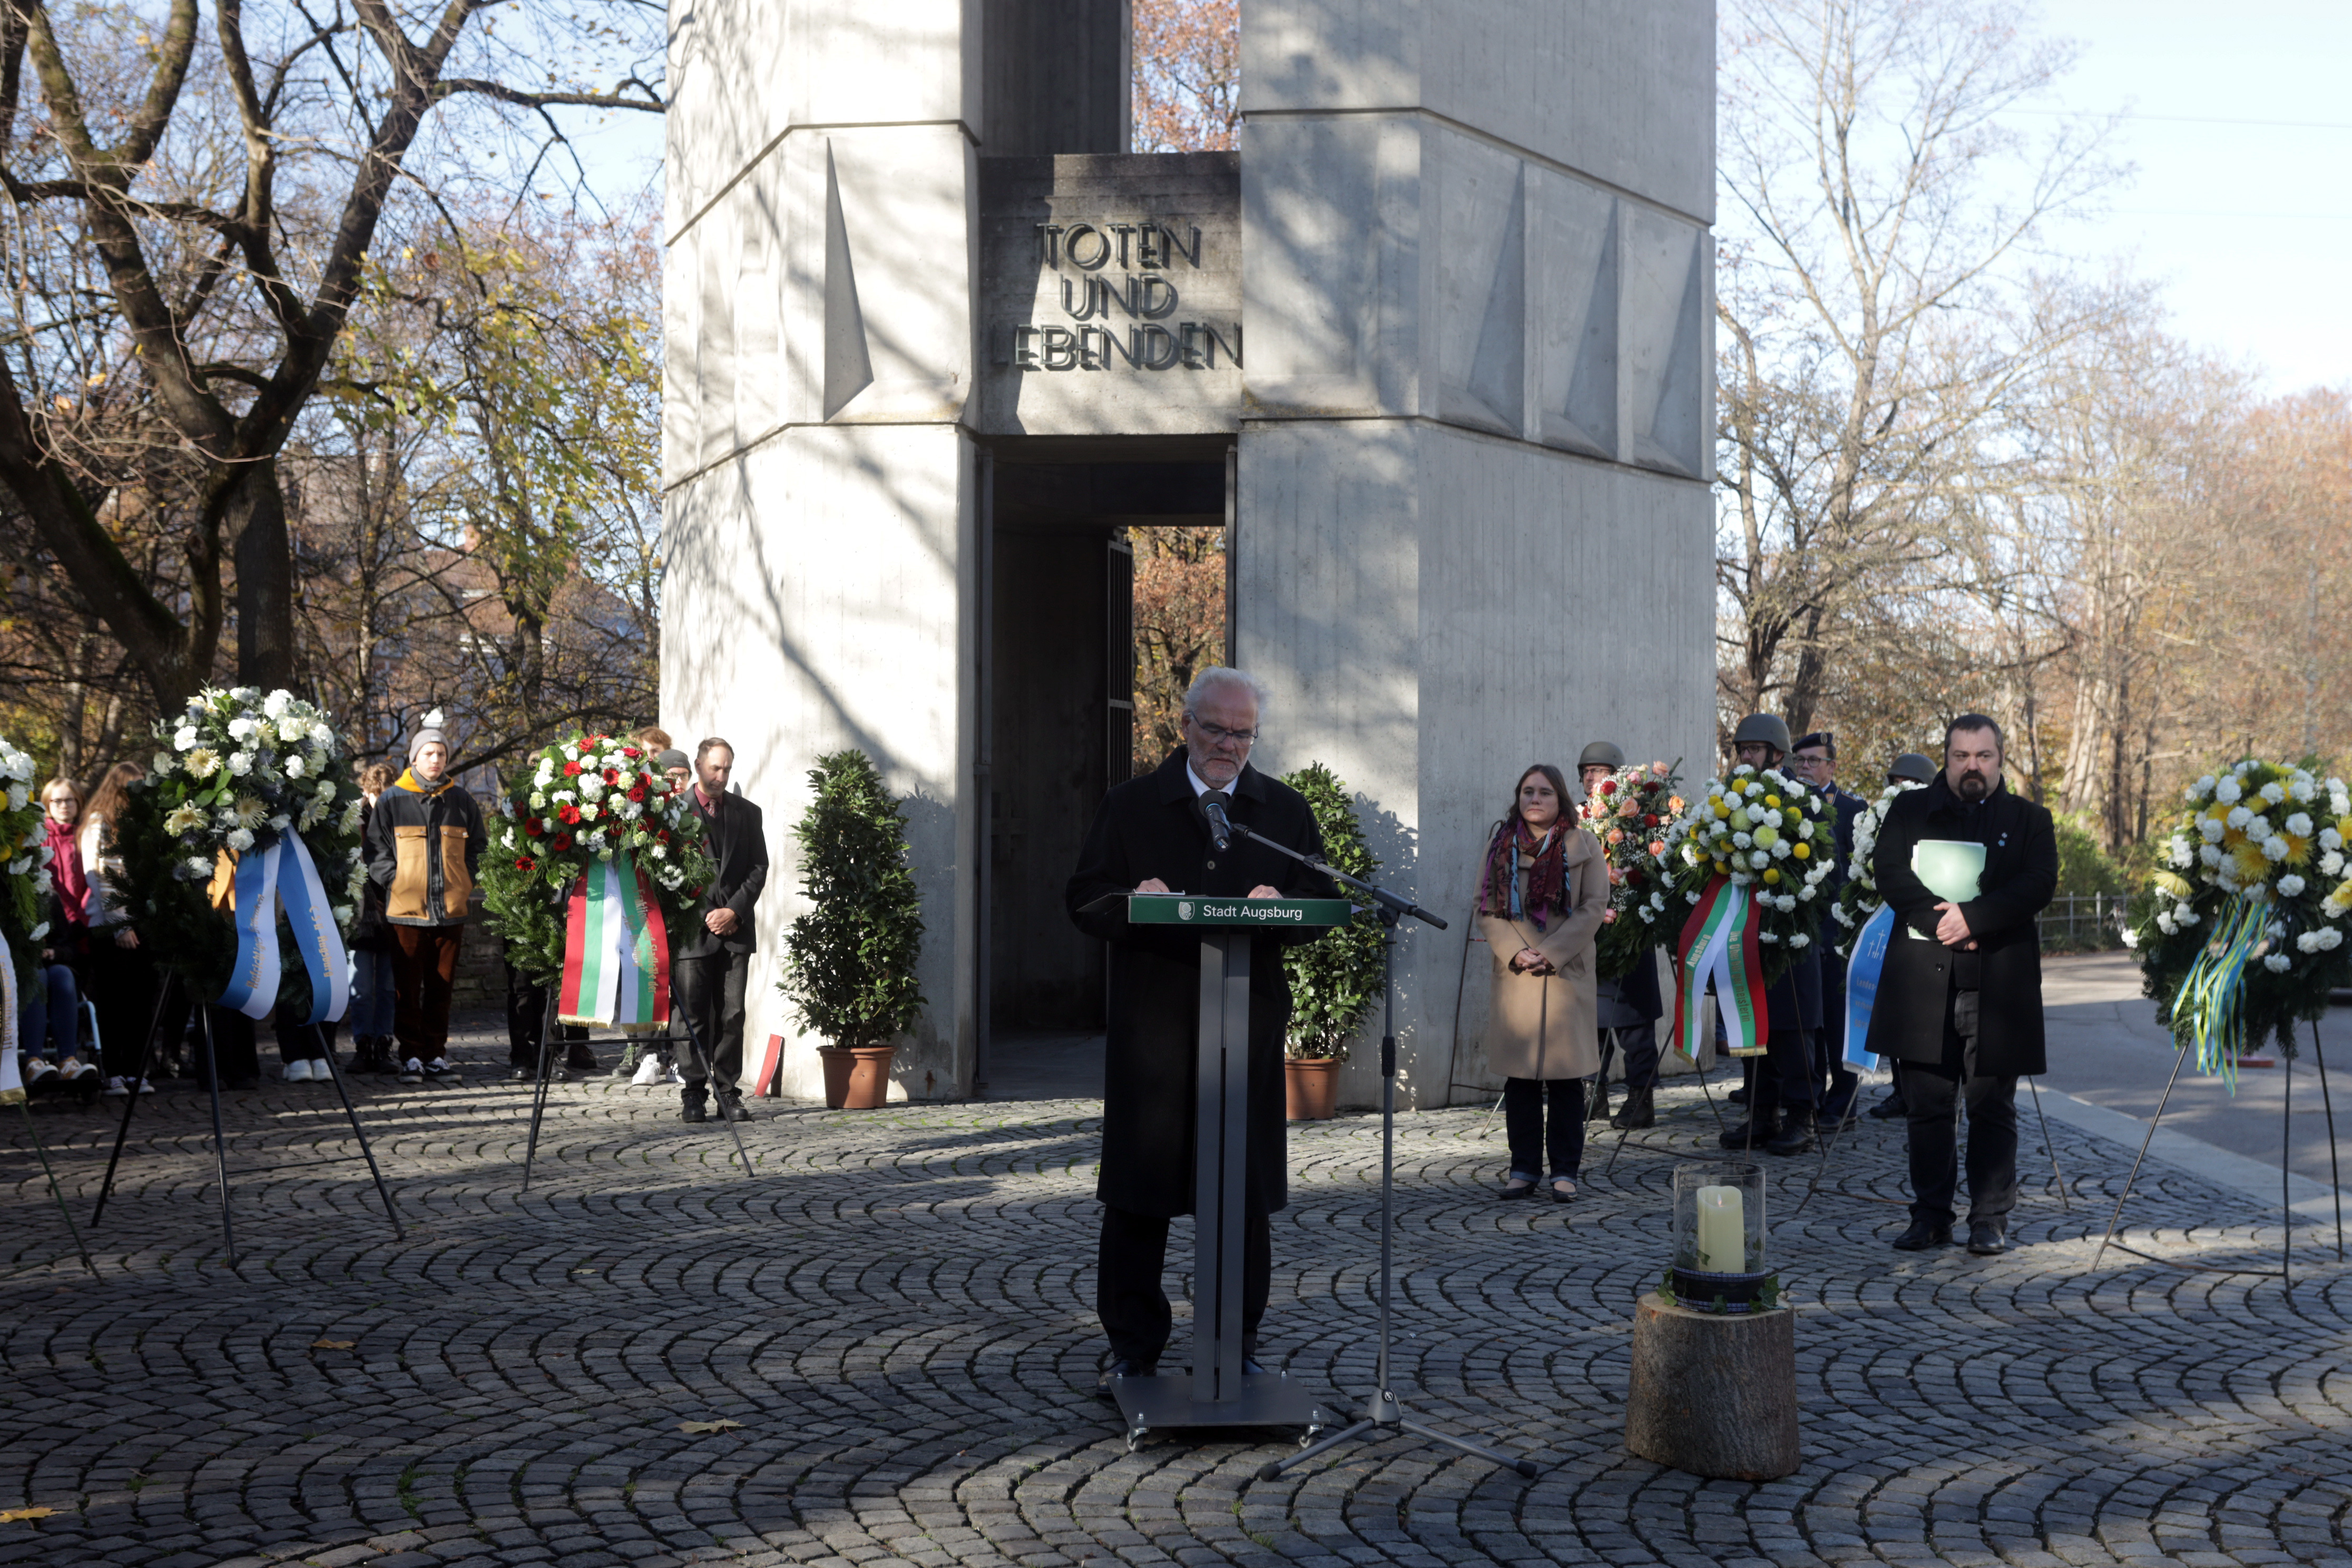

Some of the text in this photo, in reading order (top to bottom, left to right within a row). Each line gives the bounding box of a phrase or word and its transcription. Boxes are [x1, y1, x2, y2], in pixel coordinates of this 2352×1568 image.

[1036, 221, 1192, 263] TOTEN
[1060, 272, 1172, 316] UND
[1203, 905, 1303, 921] Stadt Augsburg
[642, 928, 656, 942] und
[1687, 934, 1712, 968] Augsburg
[1729, 930, 1741, 942] Die
[317, 935, 334, 978] Augsburg
[645, 944, 659, 979] Stadträte
[648, 981, 659, 994] der
